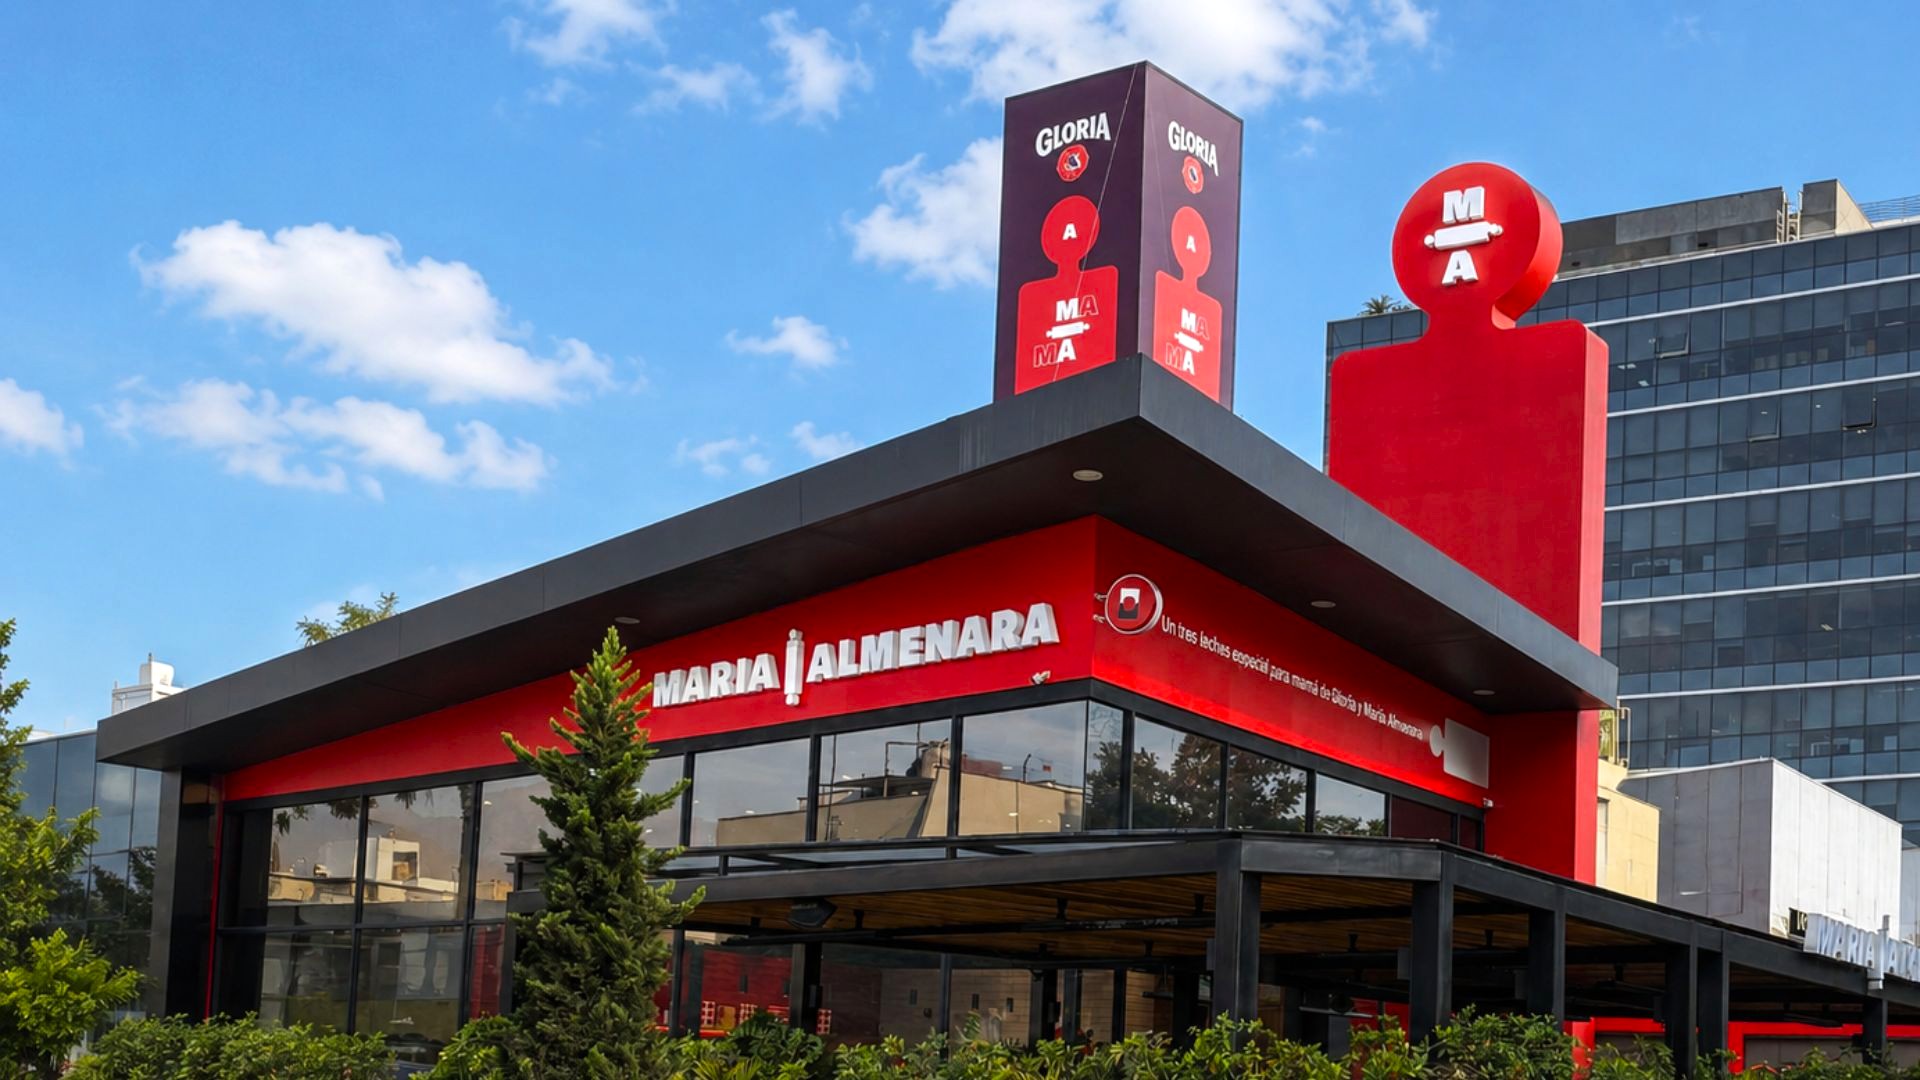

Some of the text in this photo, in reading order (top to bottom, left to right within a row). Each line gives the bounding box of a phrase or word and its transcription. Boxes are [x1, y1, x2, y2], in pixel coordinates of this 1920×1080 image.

[1036, 112, 1111, 157] GLORIA
[1168, 121, 1218, 176] GLORIA
[1442, 186, 1485, 224] M
[1062, 223, 1077, 240] A
[1186, 235, 1196, 253] A
[1441, 250, 1479, 285] A
[653, 602, 1060, 708] MARIA ALMENARA
[1161, 614, 1176, 636] Un
[1178, 622, 1198, 645] tres
[1200, 631, 1231, 658] leches
[1232, 649, 1269, 674] especial
[1270, 665, 1290, 684] para
[1319, 683, 1331, 700] de
[1806, 913, 1876, 969] MARIA
